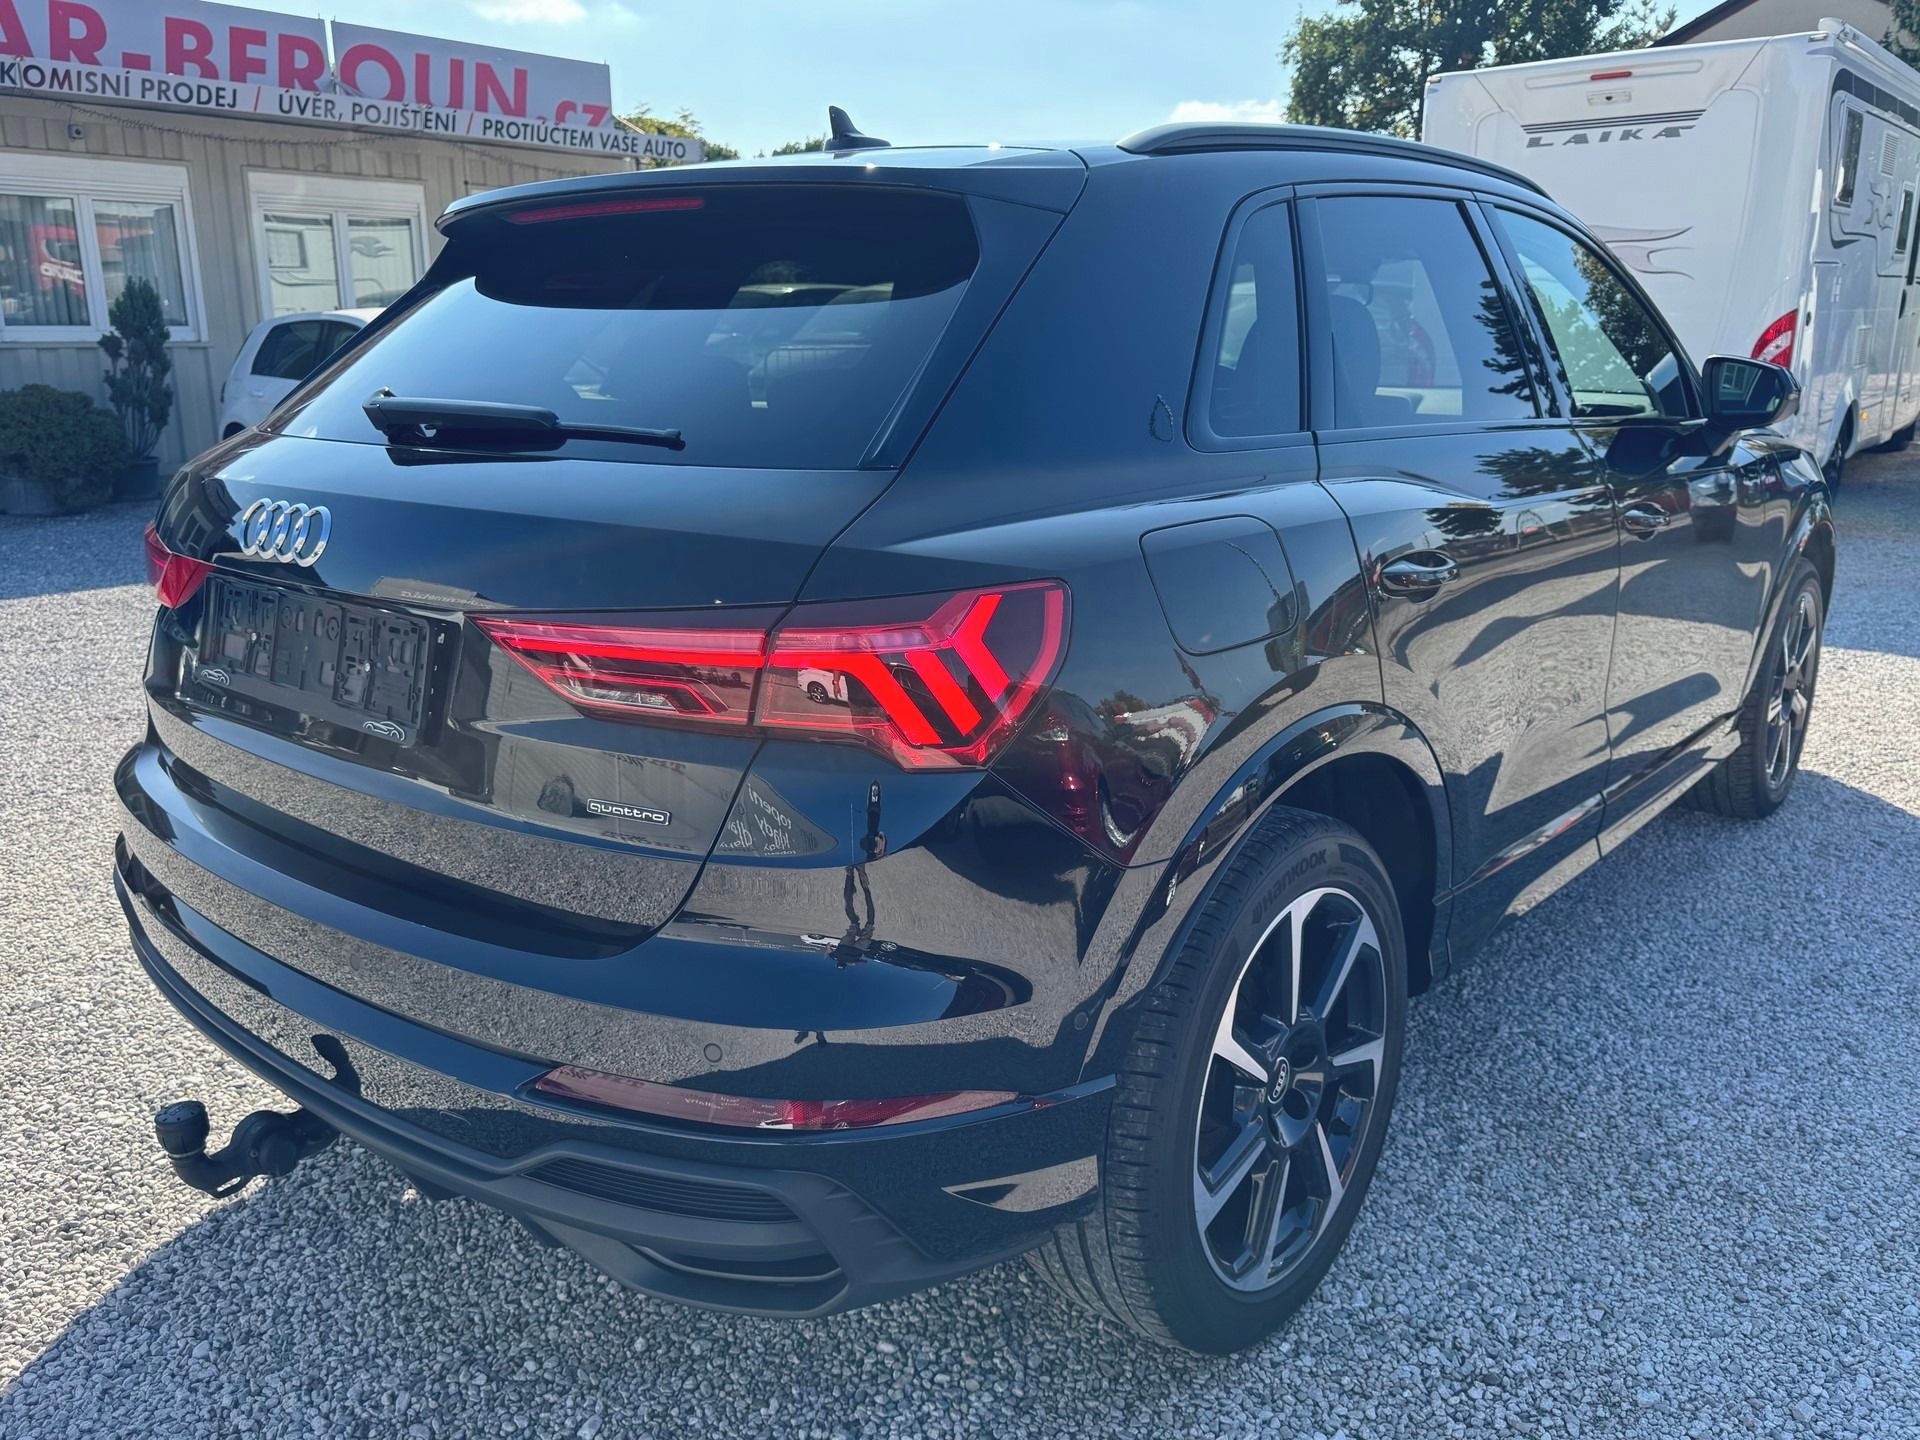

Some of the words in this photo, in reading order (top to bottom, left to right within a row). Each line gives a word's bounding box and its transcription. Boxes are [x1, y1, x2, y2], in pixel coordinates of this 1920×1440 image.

[0, 61, 131, 97] KOMISNÍ
[141, 77, 238, 109] PRODEJ
[643, 139, 687, 159] AUTO
[1525, 125, 1696, 149] LAIKA
[590, 802, 665, 822] quattro
